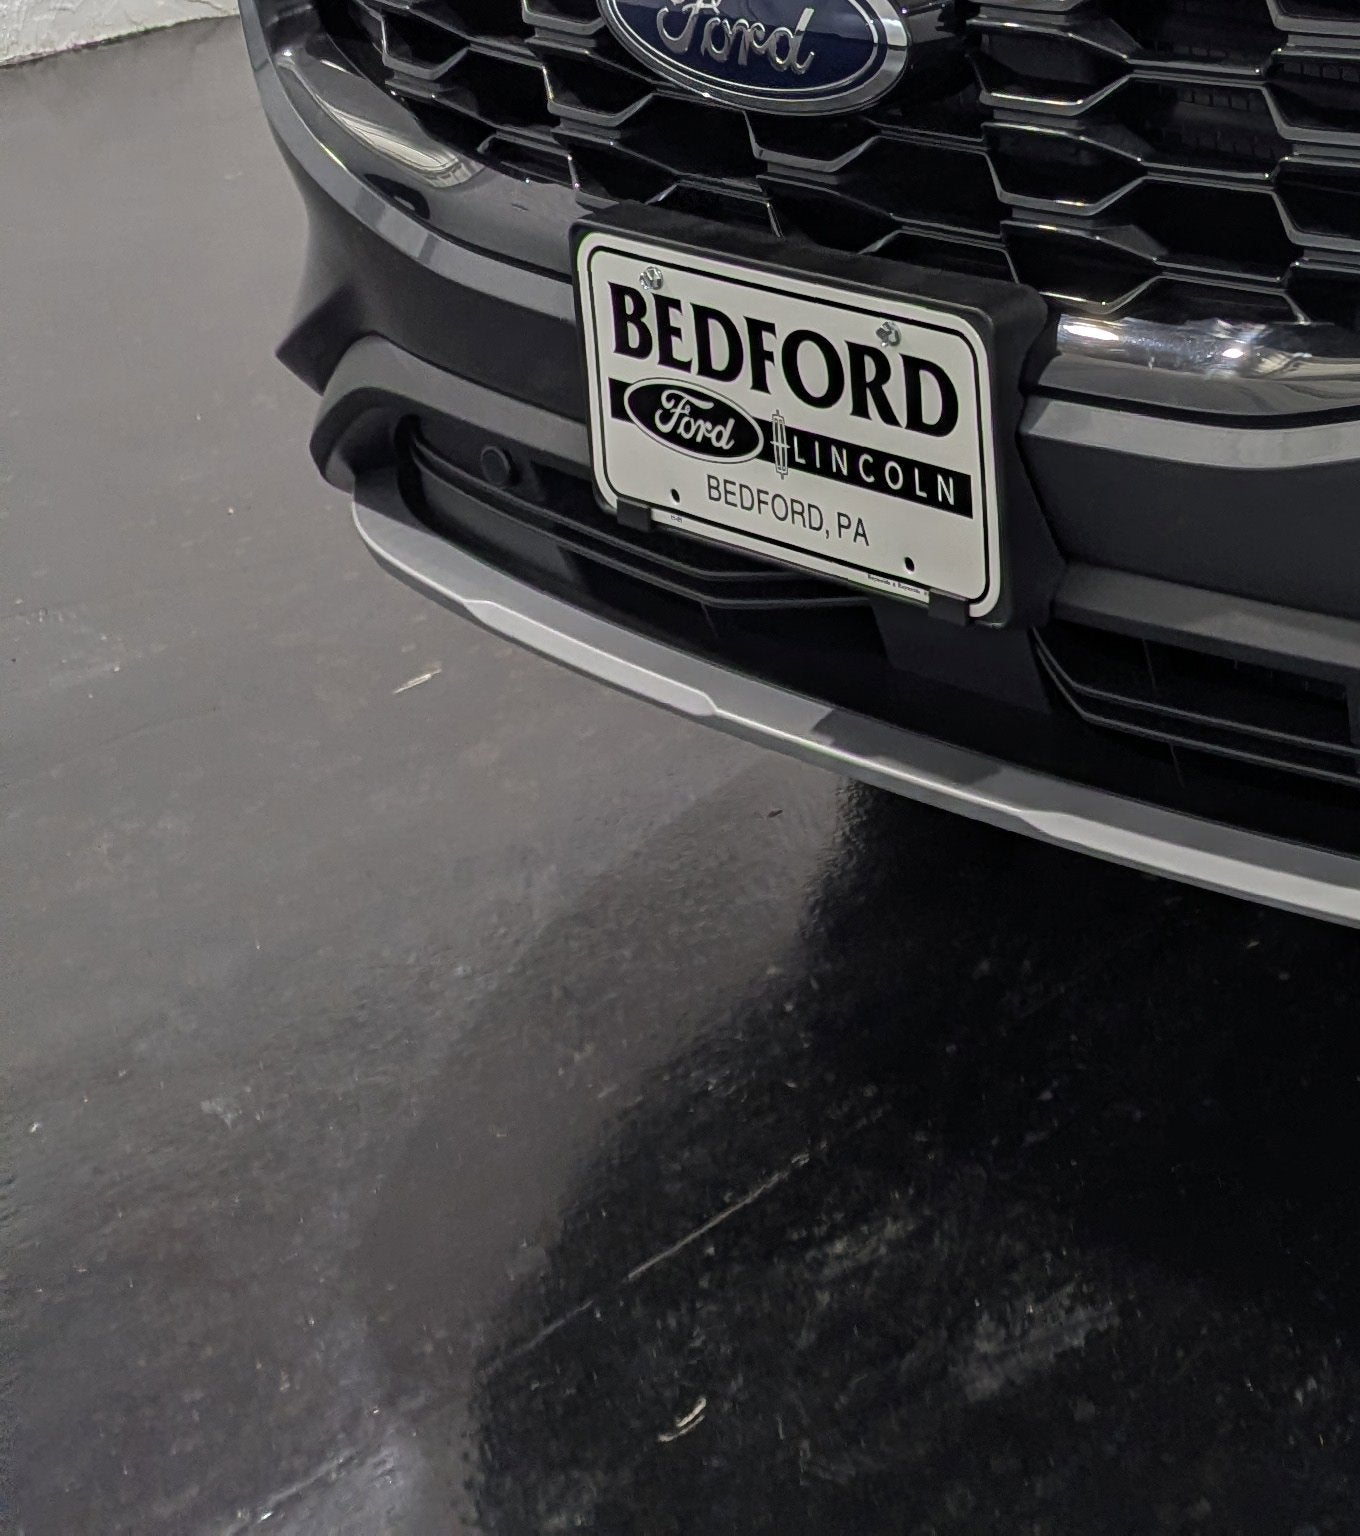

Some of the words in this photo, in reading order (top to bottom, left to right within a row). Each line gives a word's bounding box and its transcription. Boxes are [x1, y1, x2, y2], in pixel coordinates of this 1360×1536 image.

[609, 282, 959, 437] BEDFORD
[654, 389, 735, 450] Ford
[793, 439, 956, 506] LINCOLN
[708, 474, 829, 539] BEDFORD,
[838, 512, 870, 547] PA
